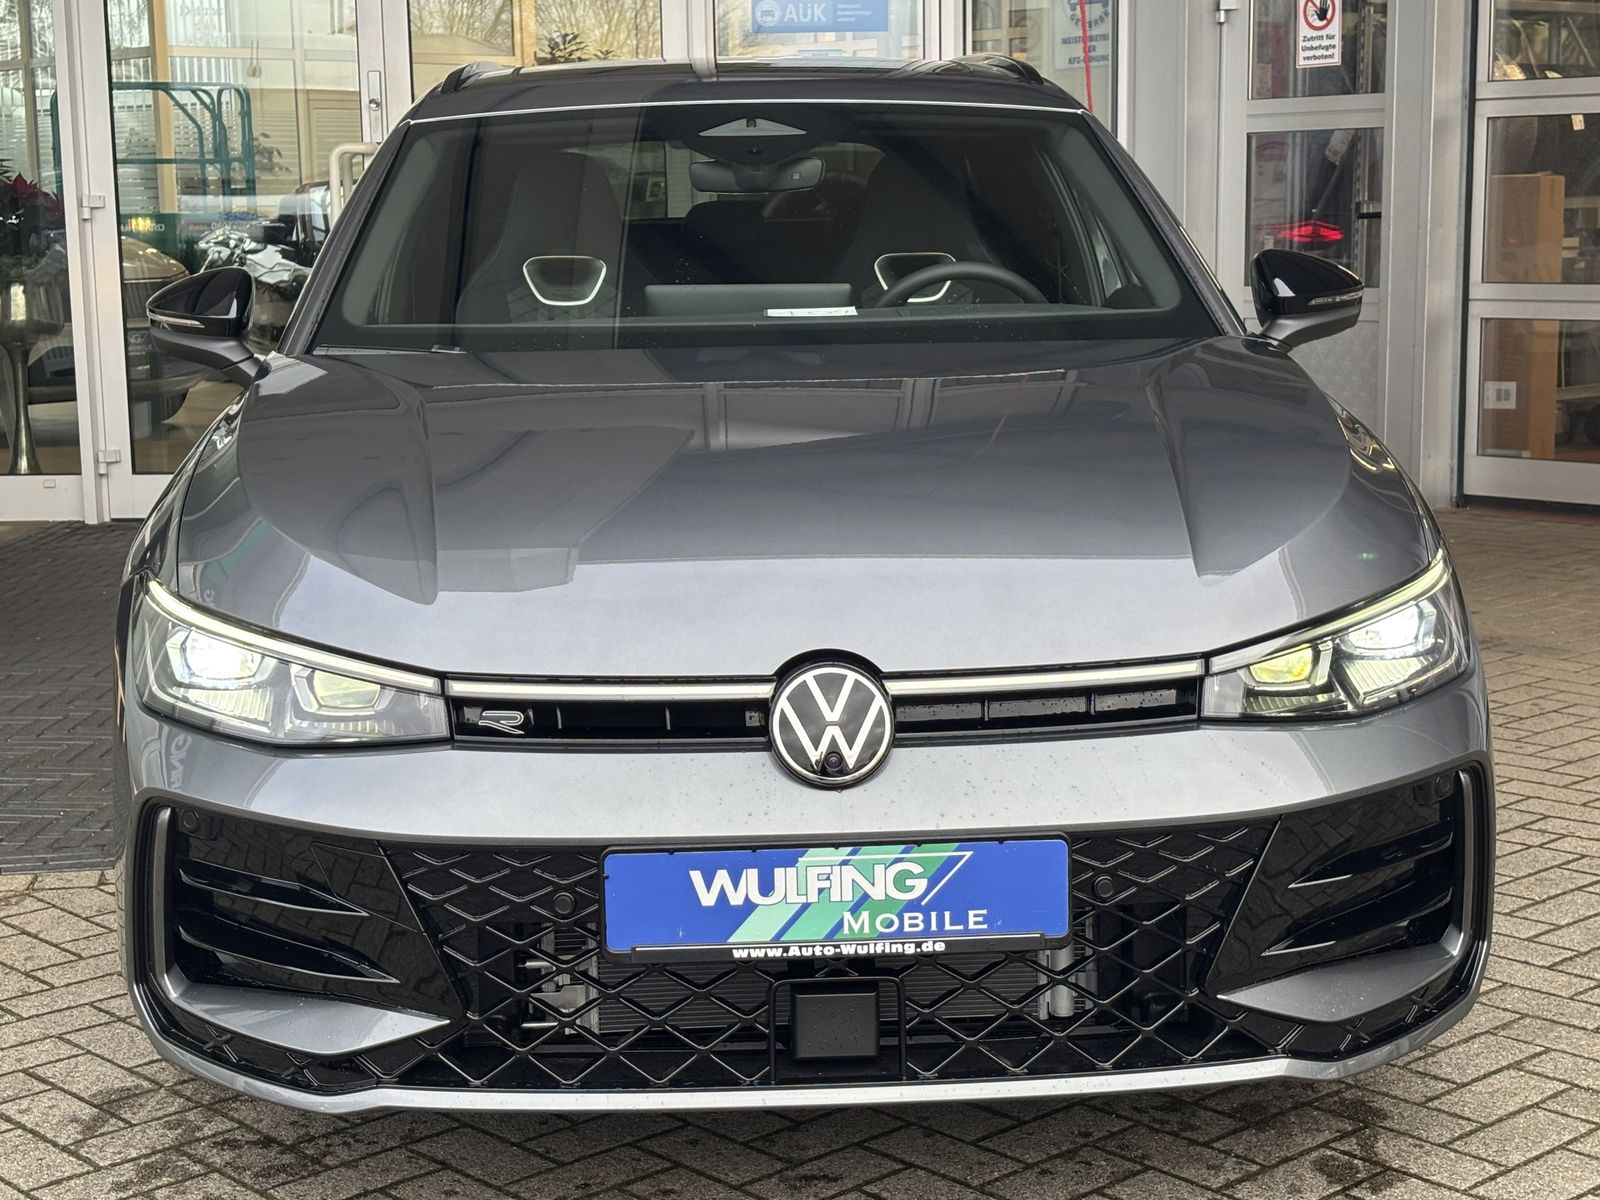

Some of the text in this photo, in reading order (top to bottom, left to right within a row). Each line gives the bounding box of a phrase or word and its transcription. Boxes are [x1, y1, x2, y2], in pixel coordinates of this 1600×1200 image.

[1302, 33, 1336, 42] Zutritt für
[1301, 43, 1336, 52] Unbefugte
[1302, 52, 1335, 61] verboten!
[688, 861, 928, 907] WULFING
[842, 909, 988, 935] MOBILE
[732, 940, 946, 959] www.Auto-Wulfing.de
